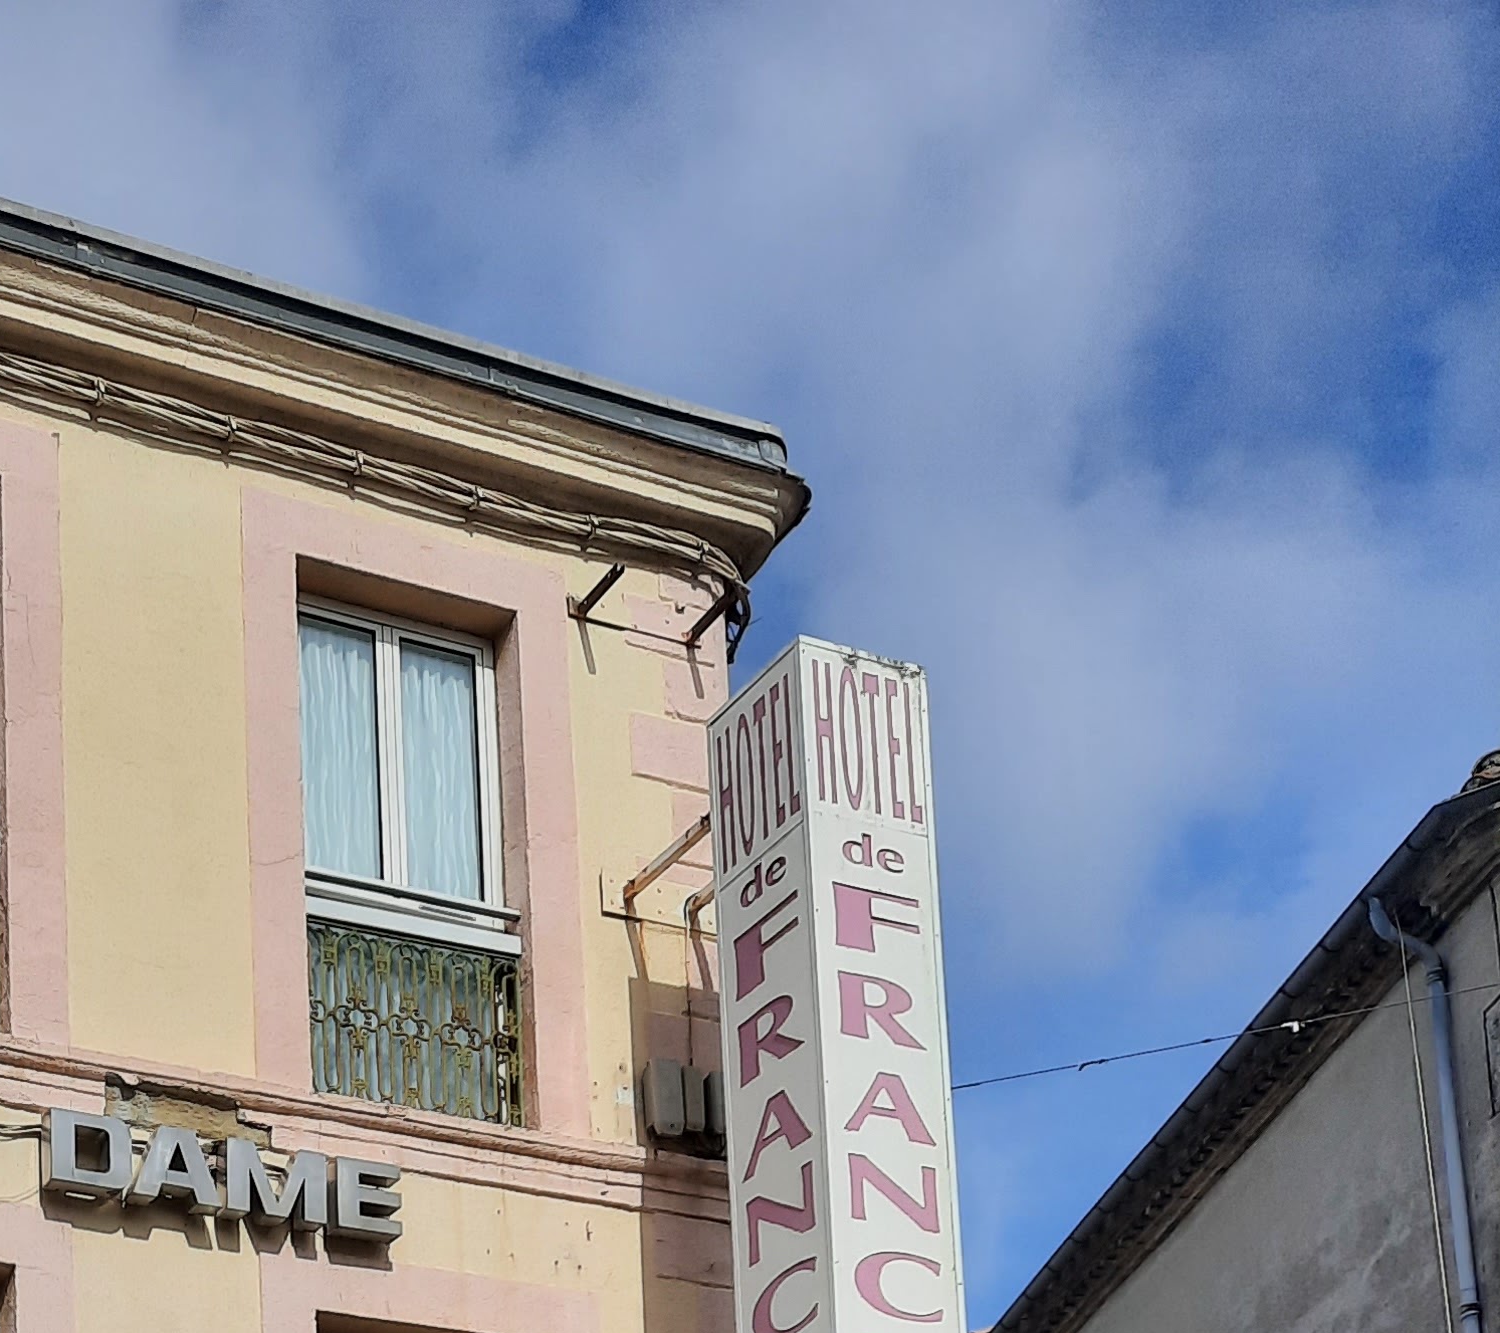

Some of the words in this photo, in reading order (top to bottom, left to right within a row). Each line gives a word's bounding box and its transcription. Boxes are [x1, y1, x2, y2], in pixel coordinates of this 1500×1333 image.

[716, 673, 801, 875] HOTEL
[812, 659, 924, 825] HOTEL
[740, 855, 788, 908] de
[842, 833, 905, 874] de
[41, 1107, 404, 1244] DAME
